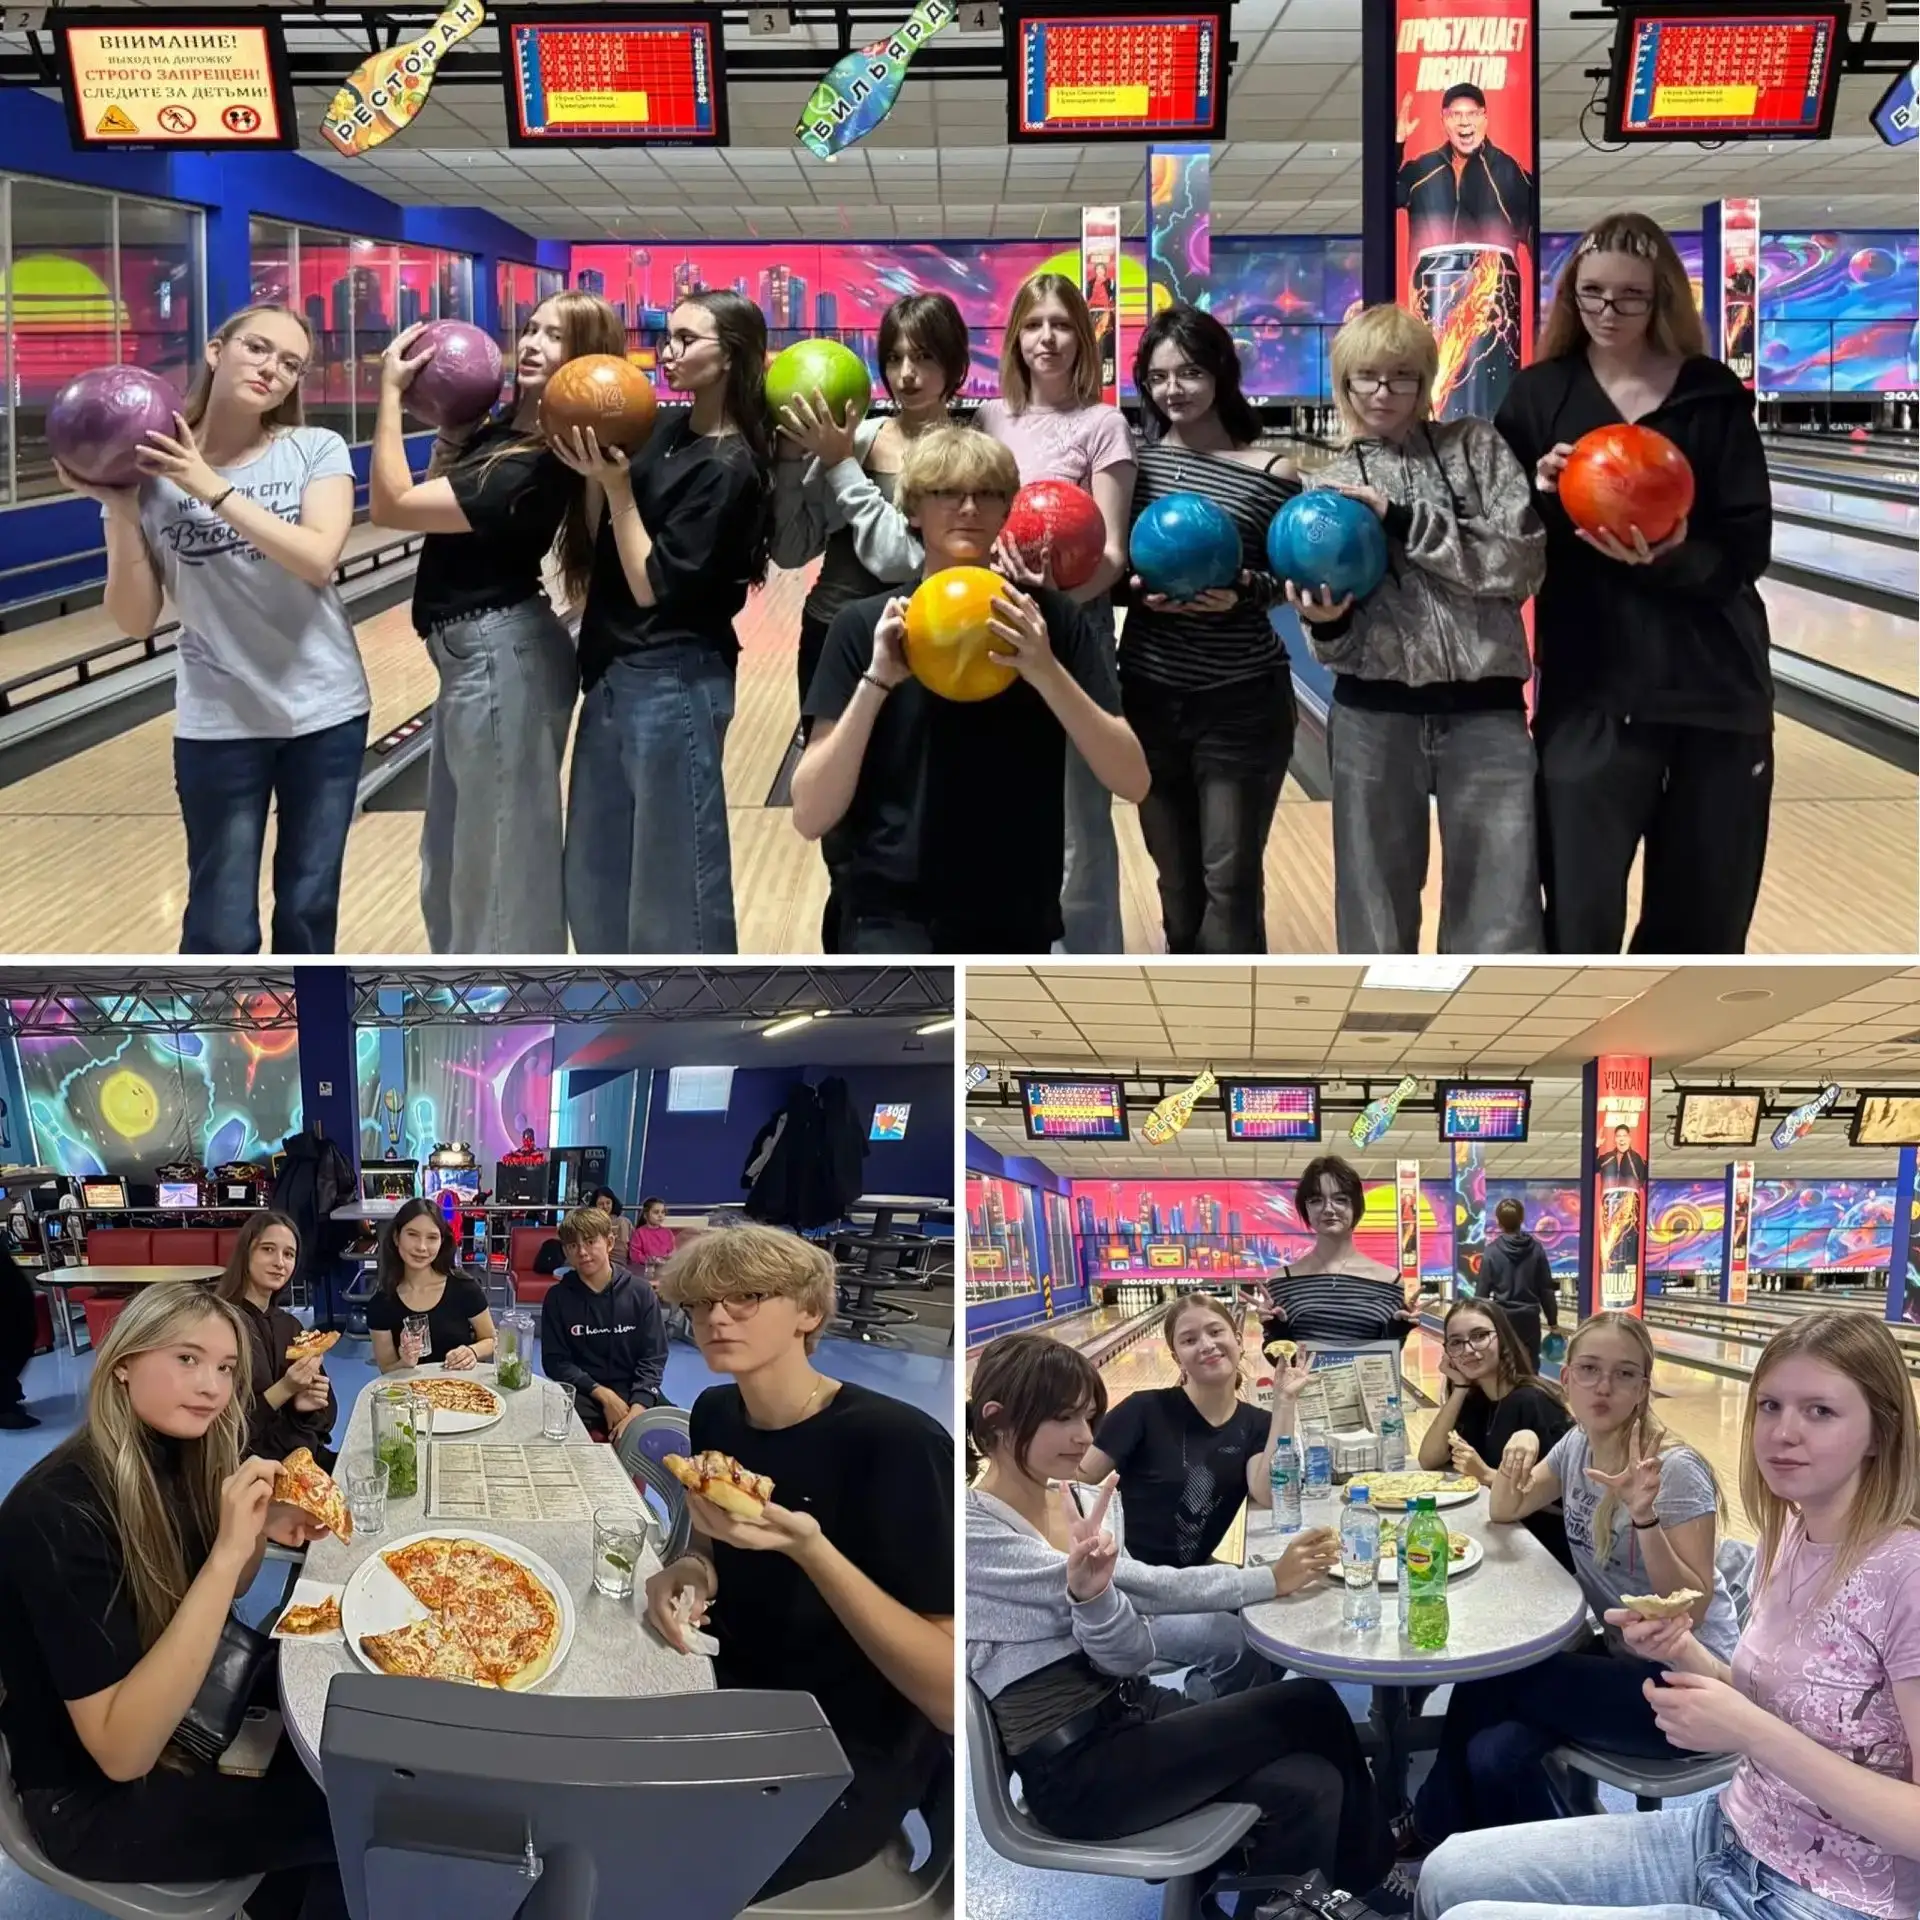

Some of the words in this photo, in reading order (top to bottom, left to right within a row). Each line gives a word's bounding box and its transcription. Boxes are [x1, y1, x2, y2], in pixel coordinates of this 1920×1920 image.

[1860, 1, 1872, 18] 5
[17, 13, 31, 28] 2
[763, 15, 774, 31] 3
[972, 10, 984, 27] 4
[99, 35, 238, 49] ВНИМАНИЕ!
[1397, 17, 1528, 55] ПРОБУЖДАЕТ
[108, 56, 151, 65] ВЫХОД
[154, 56, 170, 64] НА
[173, 55, 233, 65] ДОРОЖКУ
[85, 69, 152, 81] СТРОГО
[157, 69, 260, 82] ЗАПРЕЩЕН!
[337, 4, 475, 141] РЕСТОРАН
[813, 2, 946, 138] БИЛЬЯРД
[1416, 56, 1508, 92] ПОЗИТИВ
[83, 87, 161, 100] СЛЕДИТЕ
[166, 87, 187, 98] ЗА
[192, 87, 269, 99] ДЕТЬМИ!
[260, 482, 292, 497] CITY
[1604, 1070, 1644, 1091] VULKAN
[1122, 1277, 1175, 1286] ЗОЛОТОЙ
